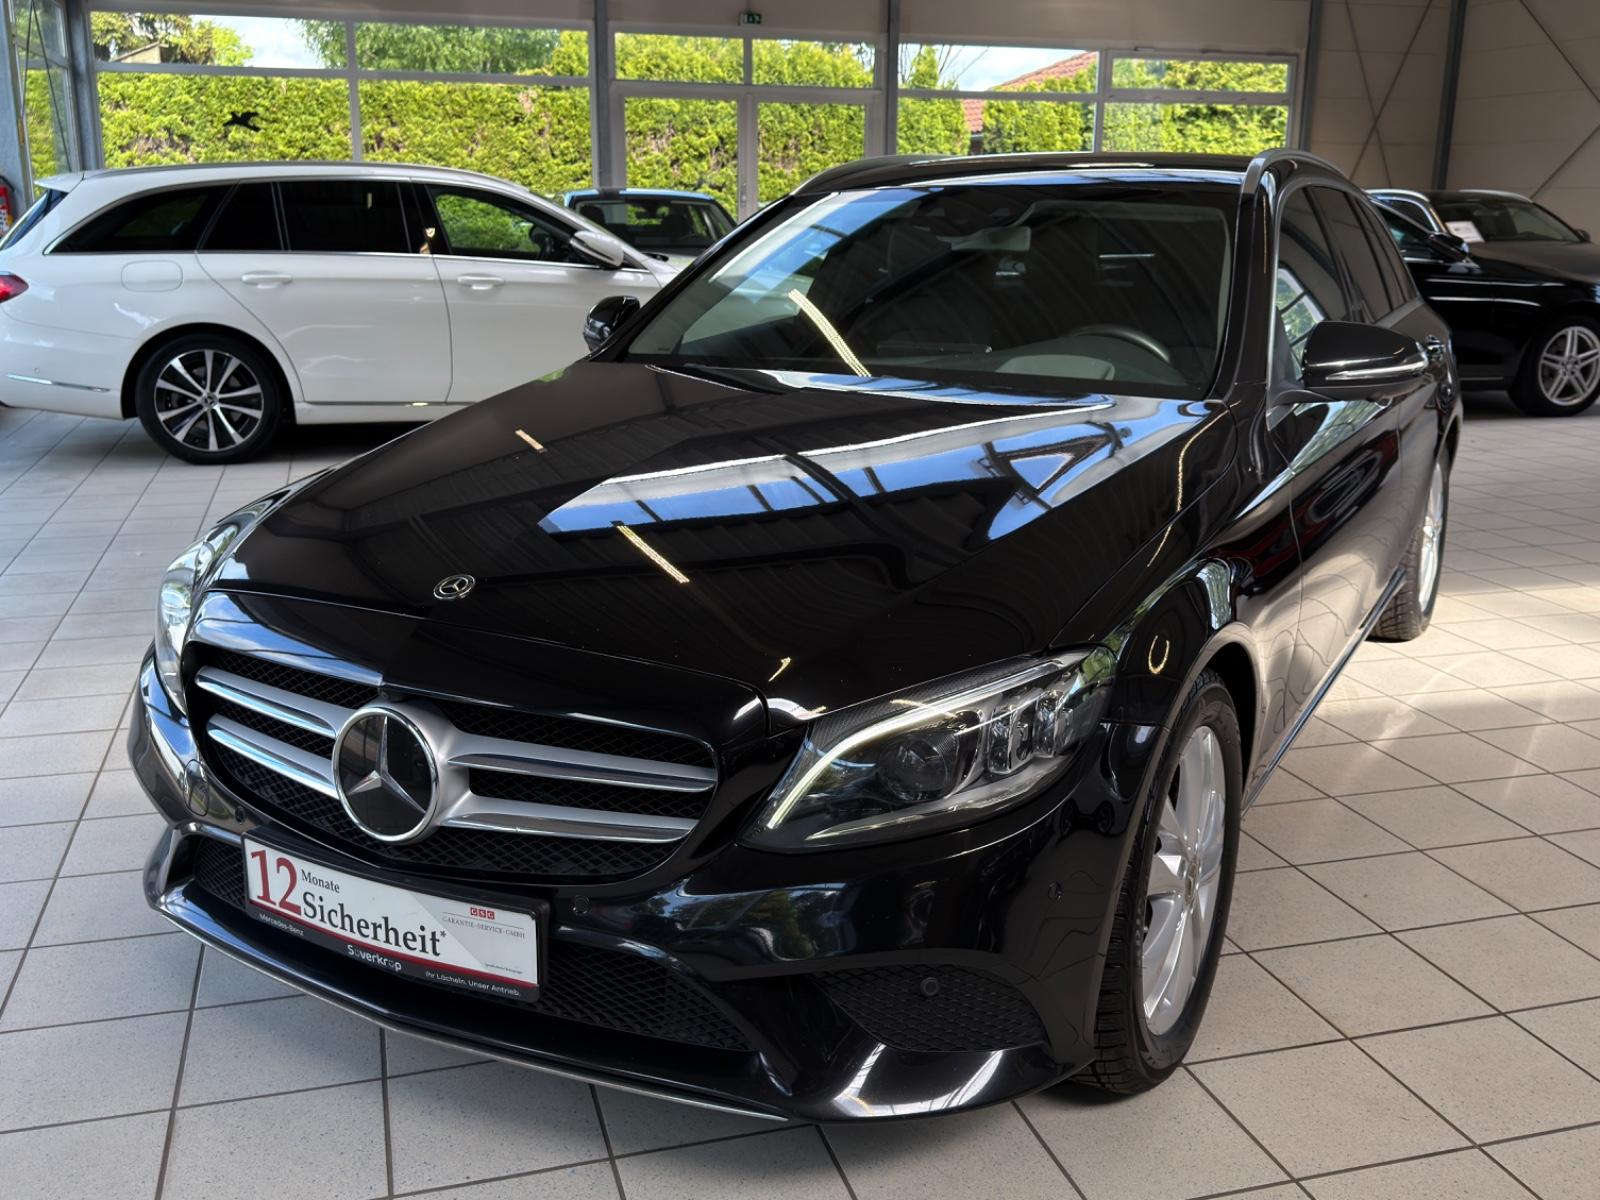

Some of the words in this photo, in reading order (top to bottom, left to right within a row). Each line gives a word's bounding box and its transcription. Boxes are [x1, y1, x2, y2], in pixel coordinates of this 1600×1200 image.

[251, 849, 302, 916] 12
[301, 869, 340, 894] Monate
[259, 913, 304, 936] Mercedes-Benz
[468, 979, 490, 990] Unser
